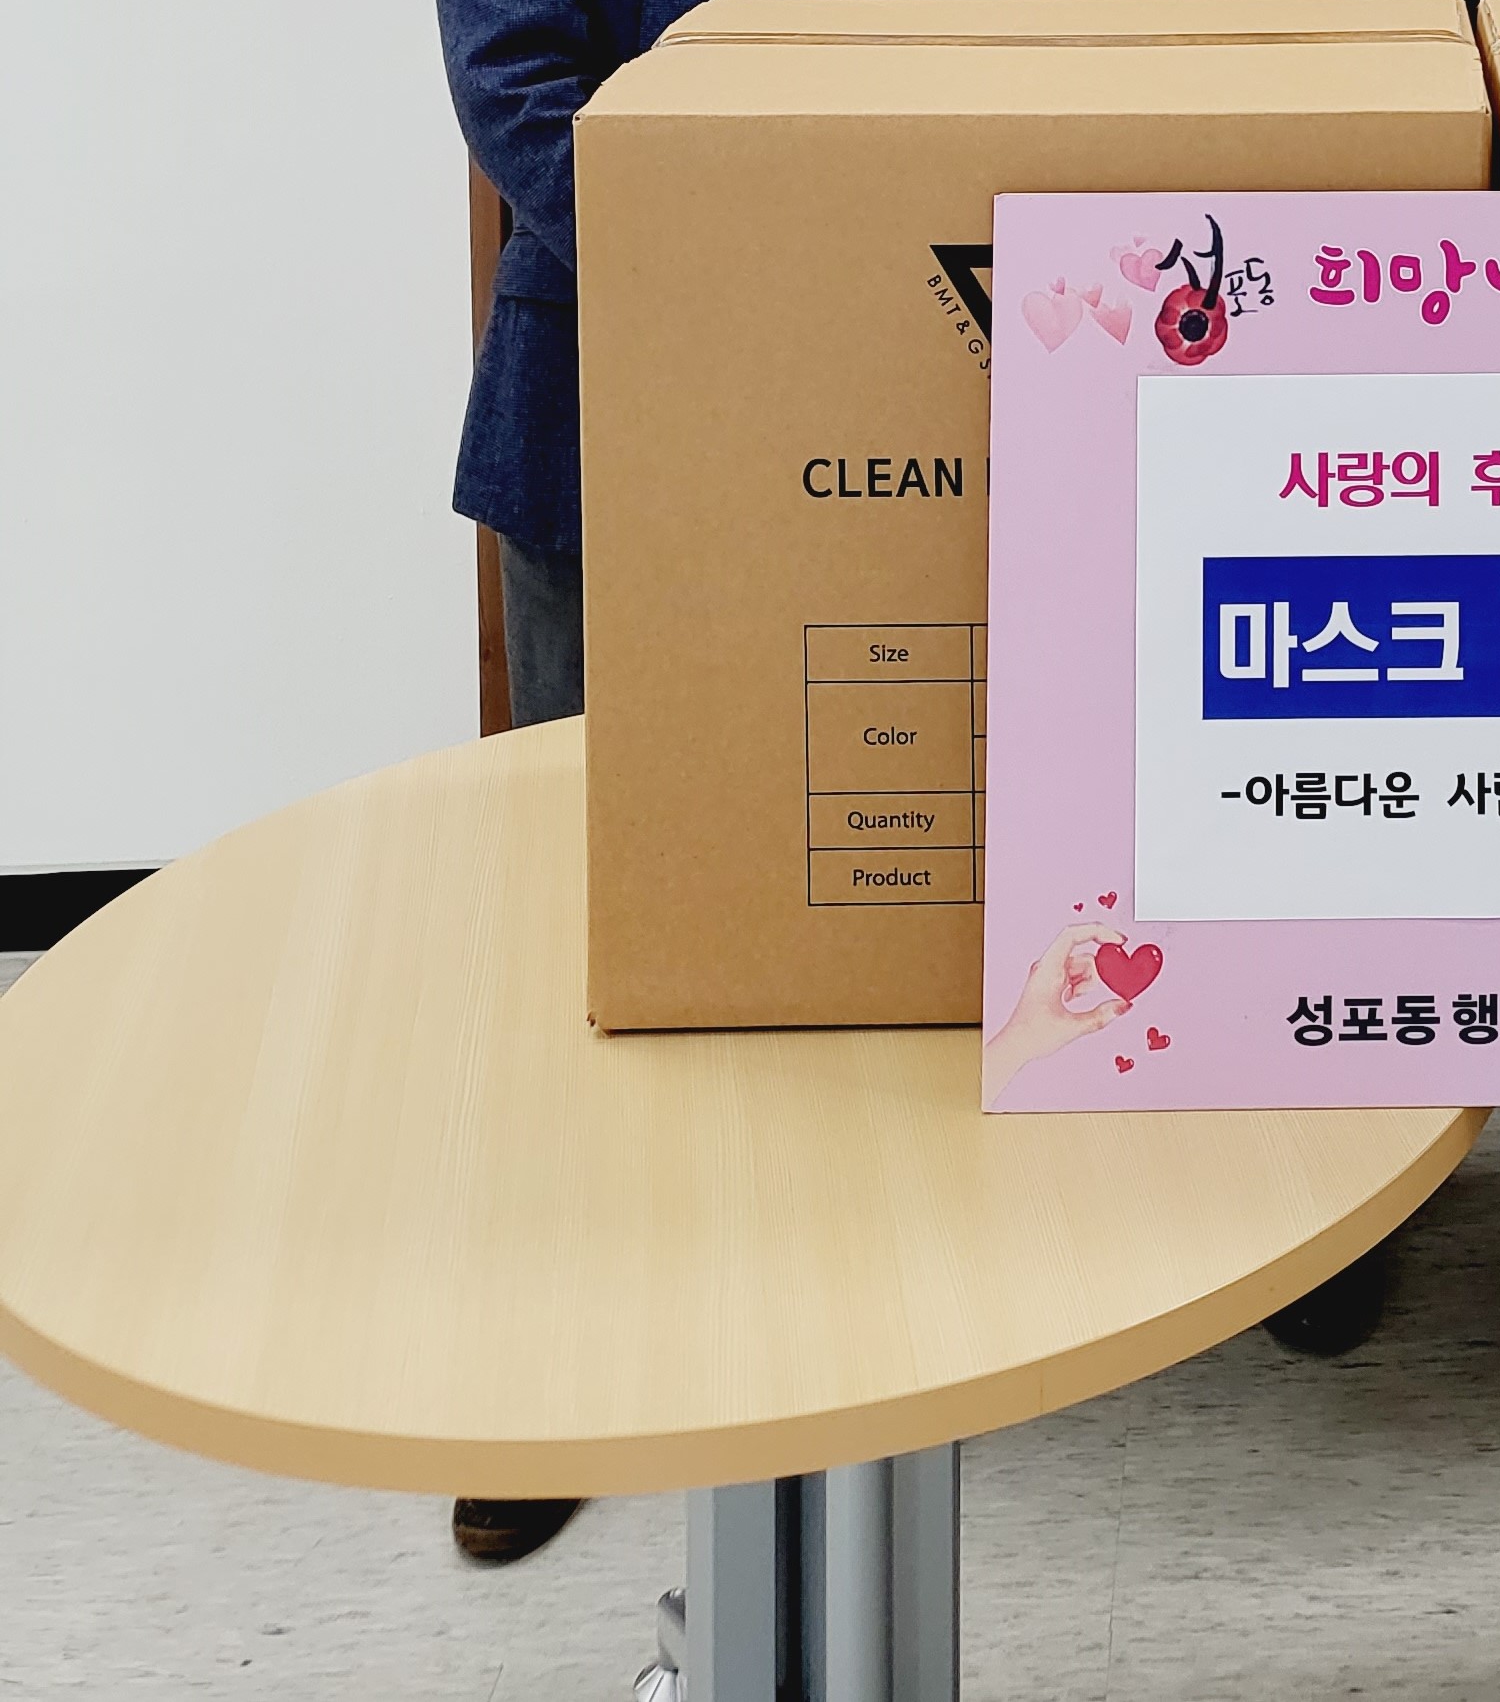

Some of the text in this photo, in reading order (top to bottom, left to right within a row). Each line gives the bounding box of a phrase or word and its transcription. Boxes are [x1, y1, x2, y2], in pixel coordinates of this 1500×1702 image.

[803, 458, 963, 499] CLEAN
[1279, 452, 1441, 509] 사랑의
[869, 644, 910, 663] Size
[1220, 602, 1465, 689] 마스크
[863, 726, 918, 747] Color
[1221, 772, 1421, 821] -아름다운
[847, 810, 936, 835] Quantity
[852, 867, 932, 889] Product
[1286, 995, 1442, 1048] 성포동
